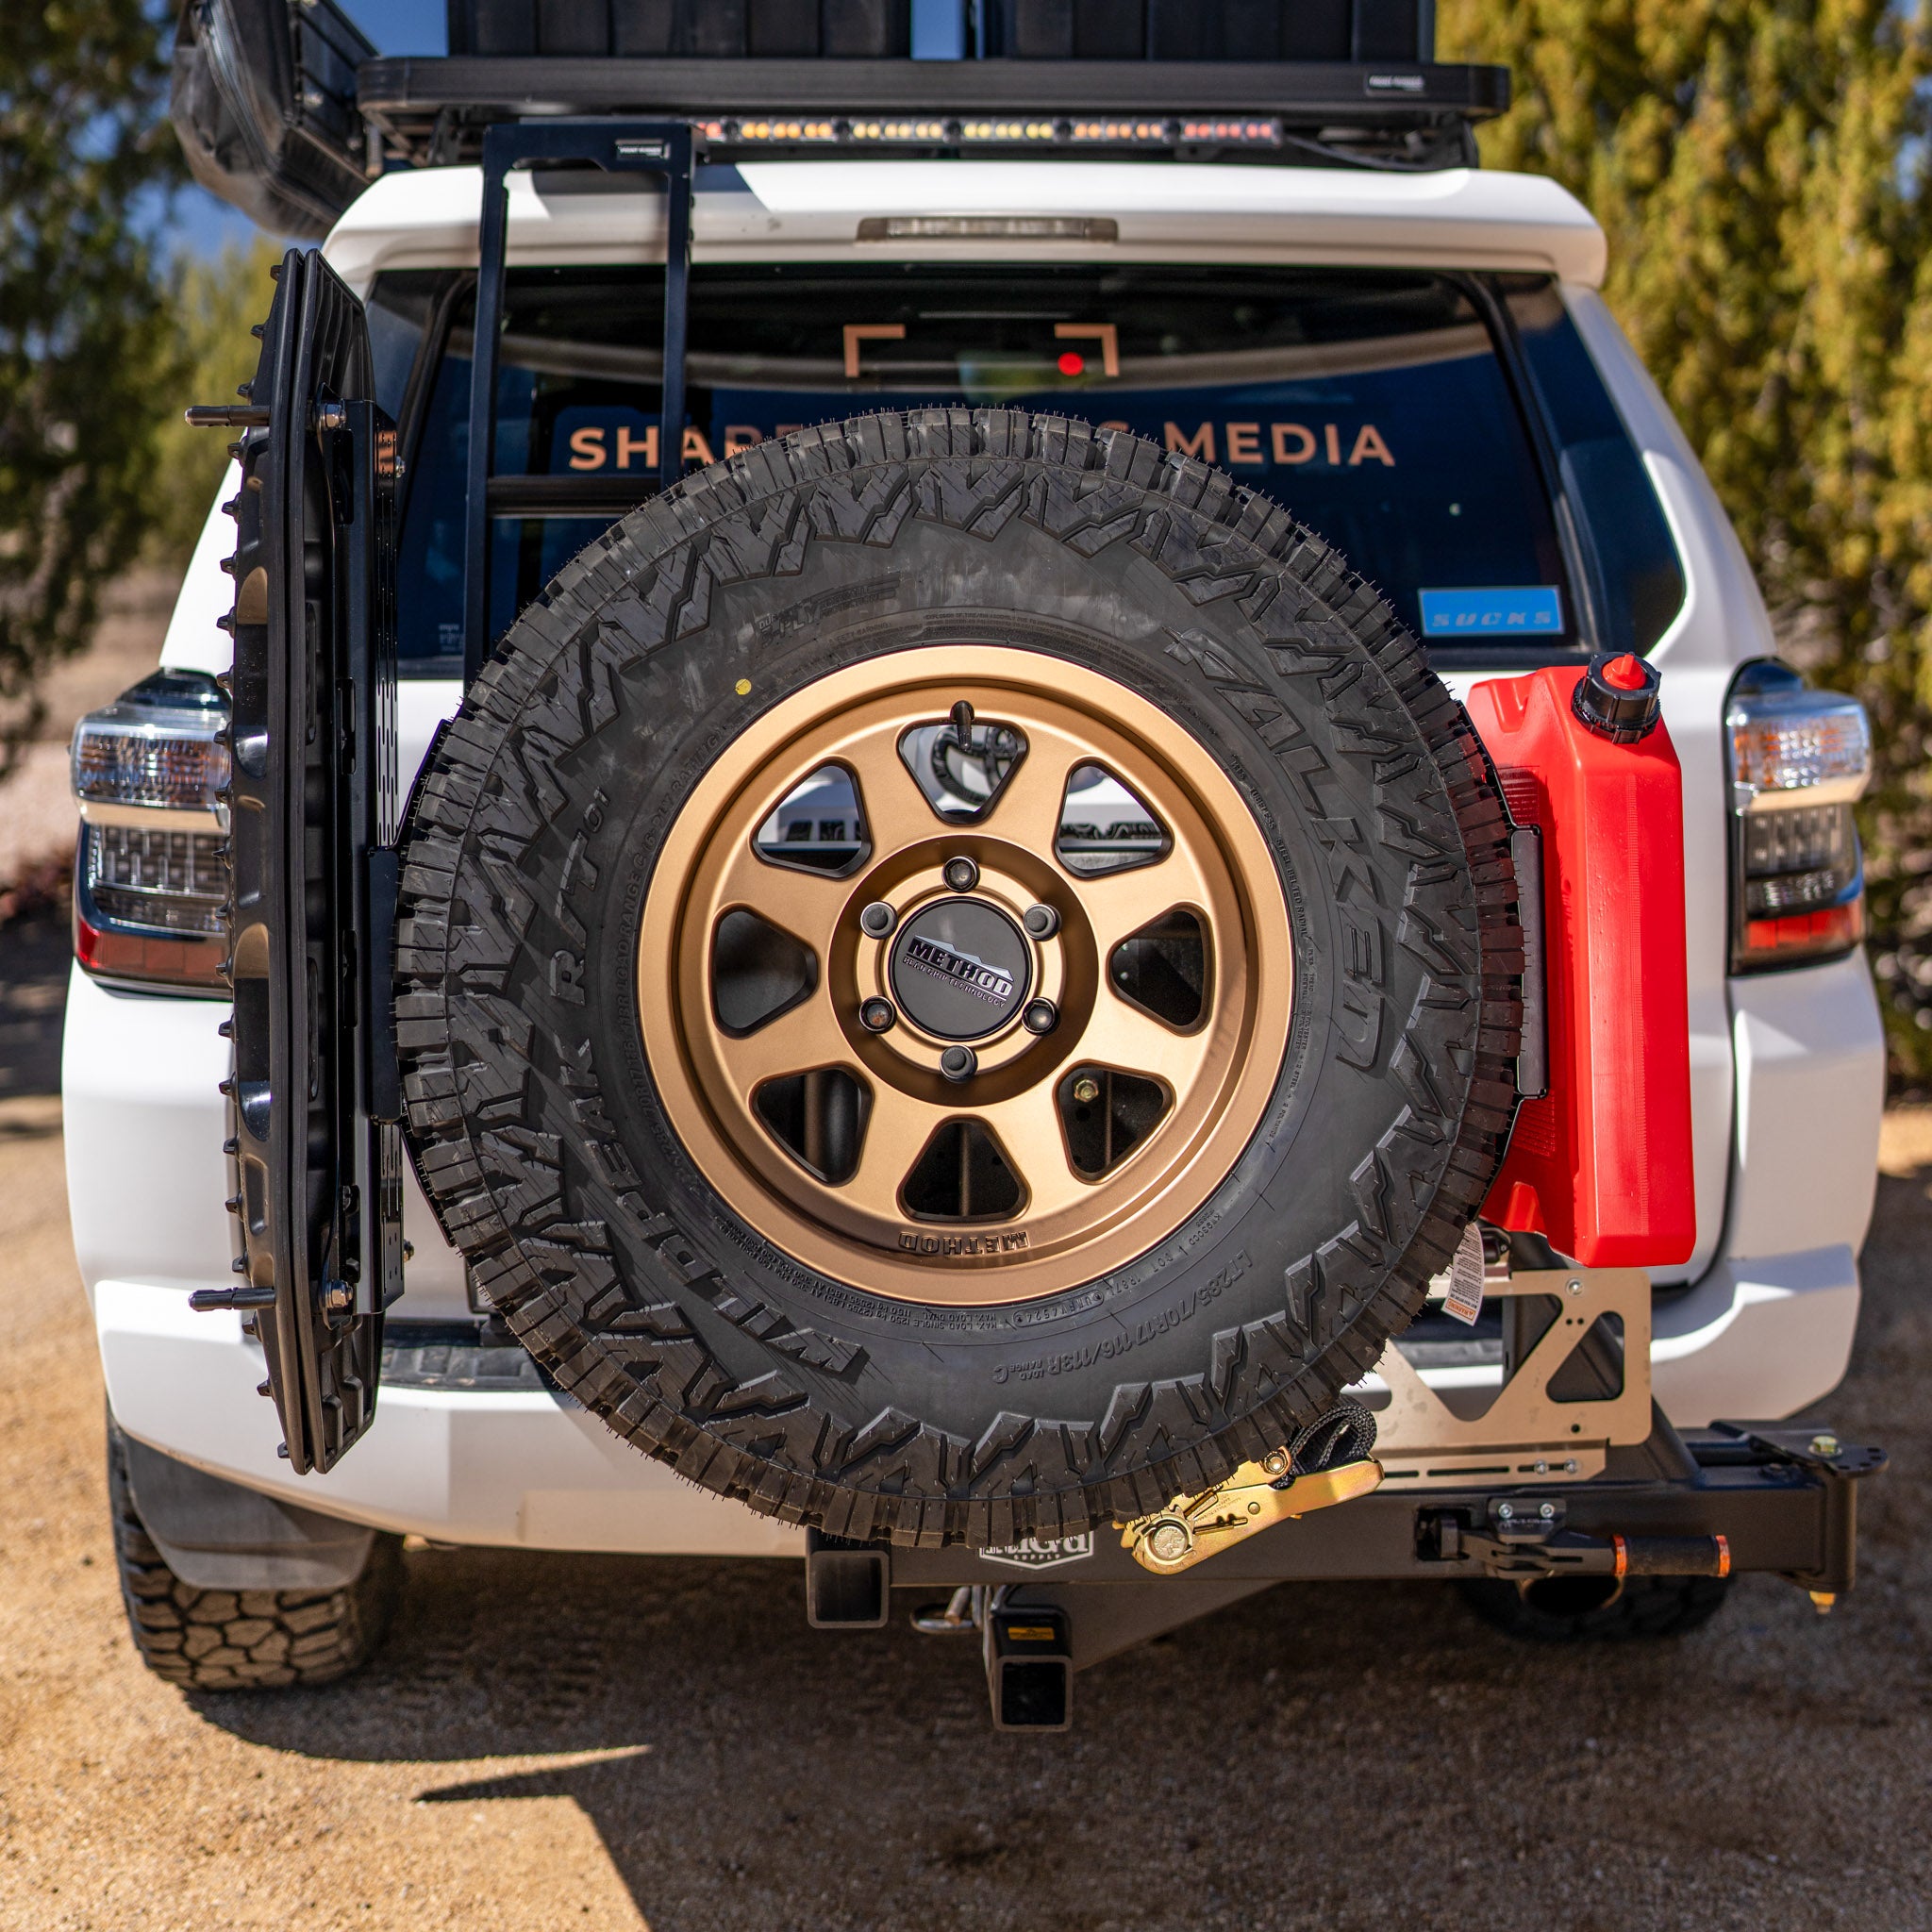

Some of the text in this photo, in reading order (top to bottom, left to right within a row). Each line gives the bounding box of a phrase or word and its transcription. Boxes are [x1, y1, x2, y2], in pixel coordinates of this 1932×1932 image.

[1163, 421, 1396, 467] MEDIA
[1432, 610, 1552, 627] SUCKS
[668, 726, 726, 794] RATING)
[638, 791, 677, 852] (6-PLY
[630, 851, 650, 871] C
[1274, 837, 1291, 866] STEEL
[1285, 866, 1303, 905] BELTED
[1294, 905, 1307, 938] RADIAL
[616, 871, 643, 937] RANGE
[614, 939, 630, 991] LOAD
[908, 938, 1014, 997] METHOD
[948, 977, 1007, 1009] TECHNOLOGY
[547, 1026, 866, 1380] WILDPEAK
[898, 1231, 1031, 1256] METHOD
[1148, 1251, 1174, 1274] DOT
[808, 1286, 824, 1299] AT
[812, 1278, 826, 1291] AT
[824, 1284, 849, 1301] LBS)
[821, 1291, 846, 1308] LBS)
[875, 1301, 890, 1313] kg
[845, 1301, 874, 1318] (2755
[874, 1308, 888, 1321] kg
[890, 1306, 912, 1317] 1150
[920, 1311, 945, 1321] DUAL
[948, 1313, 973, 1322] LOAD
[974, 1312, 996, 1321] MAX.
[1043, 1245, 1259, 1377] LT285/70R17 116/113R
[888, 1313, 911, 1325] 1250
[911, 1318, 945, 1329] SINGLE
[947, 1322, 973, 1330] LOAD
[975, 1320, 997, 1330] MAX.
[990, 1357, 1044, 1385] RANGE C
[1016, 1368, 1045, 1381] LOAD
